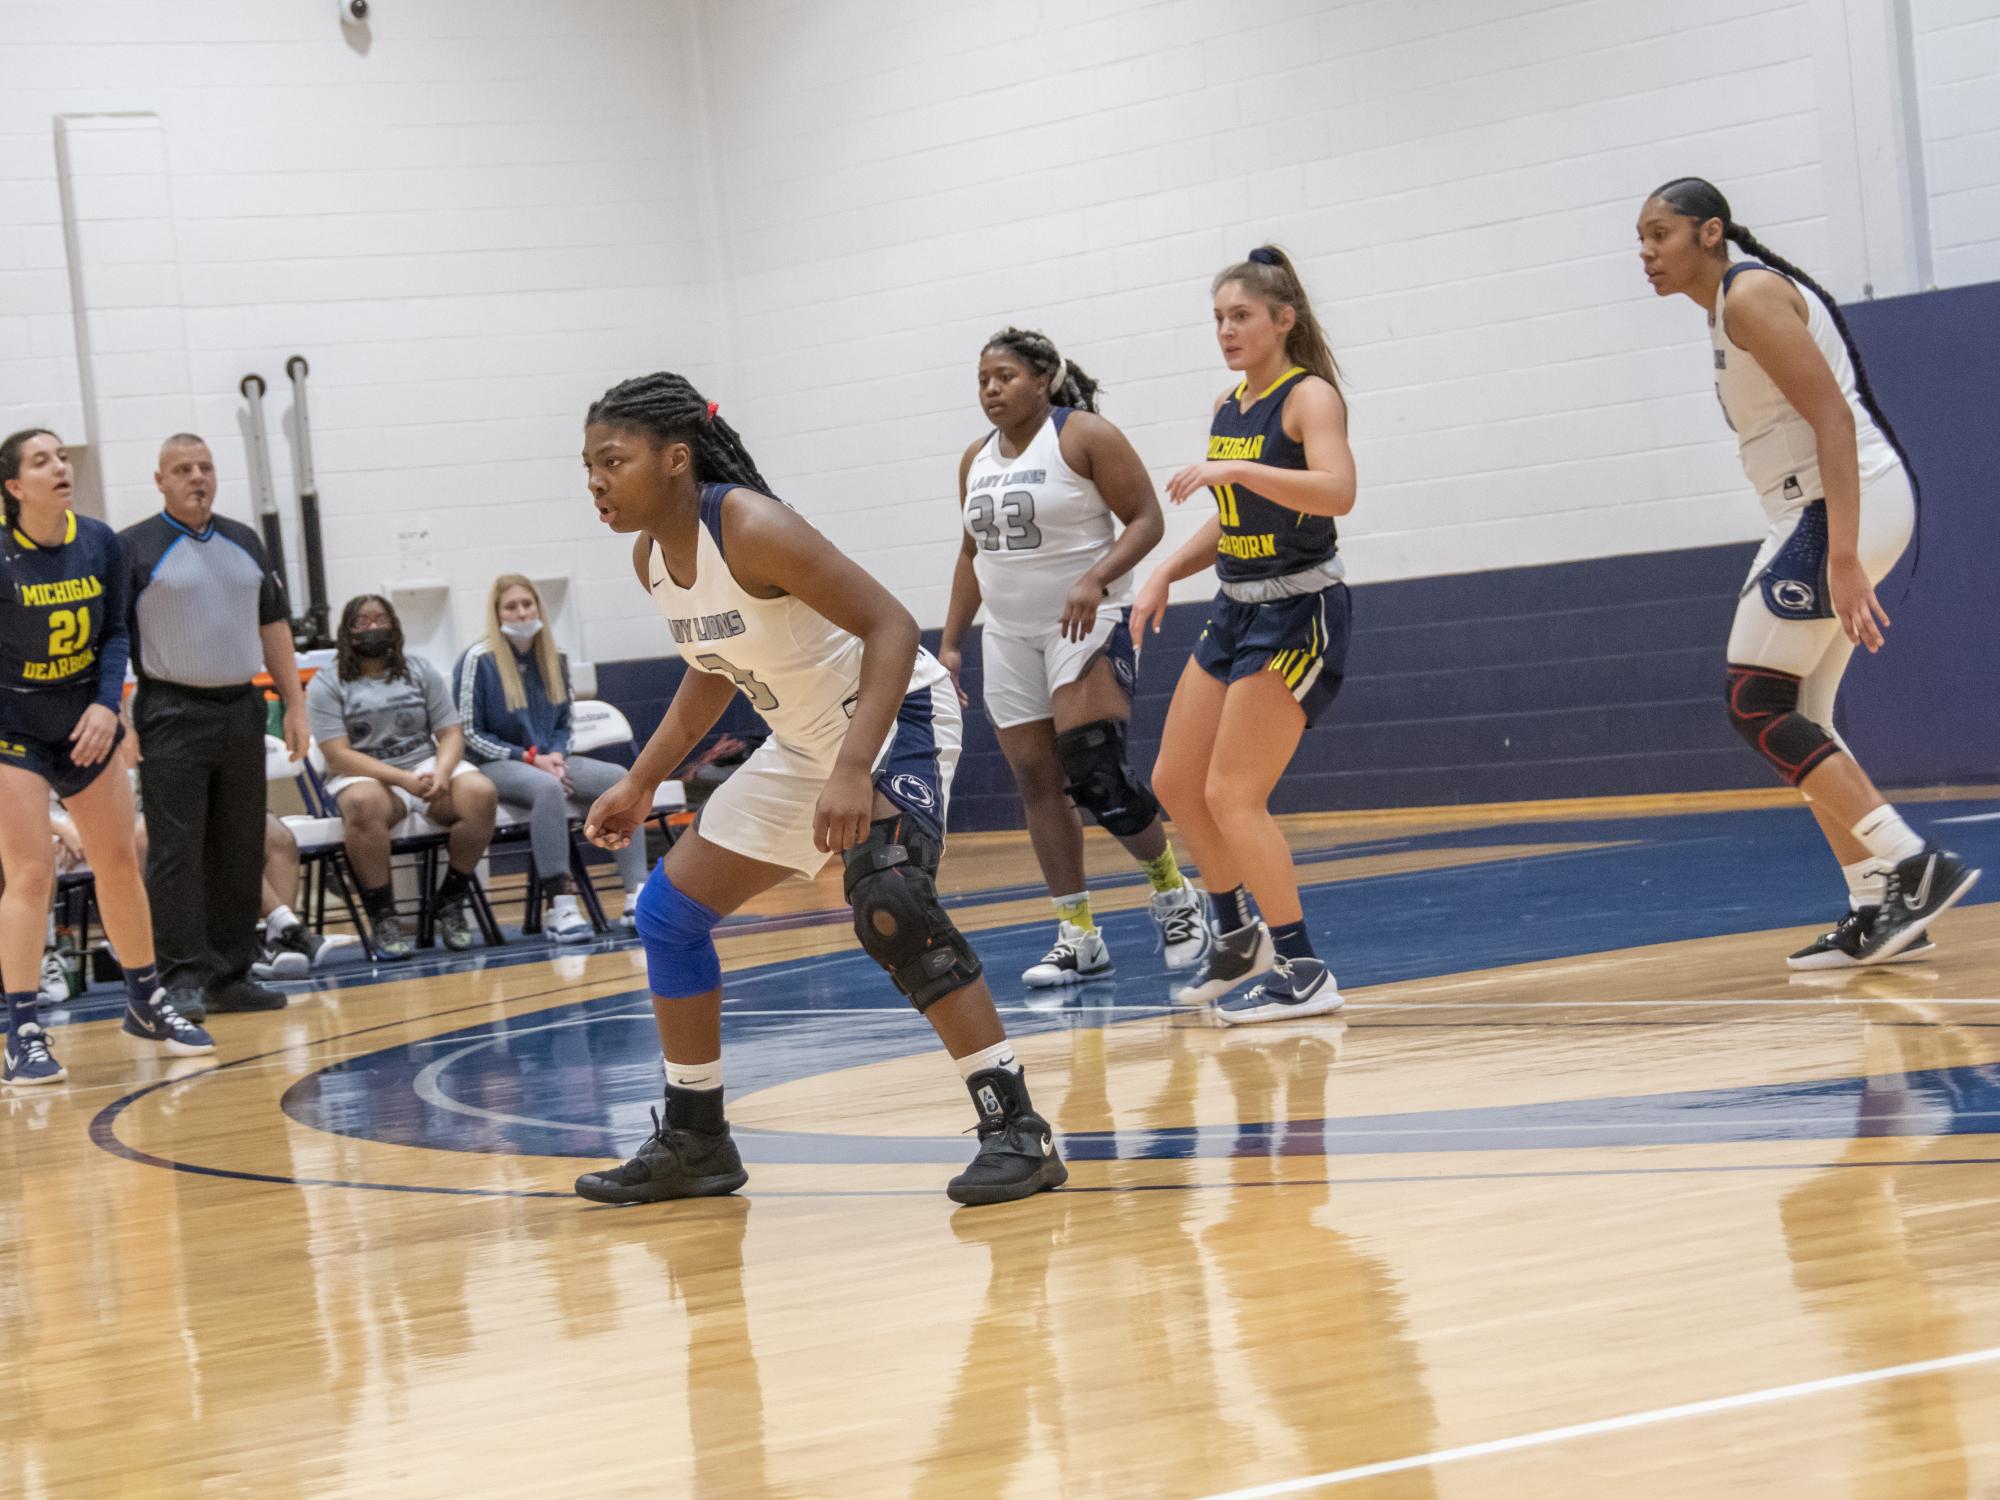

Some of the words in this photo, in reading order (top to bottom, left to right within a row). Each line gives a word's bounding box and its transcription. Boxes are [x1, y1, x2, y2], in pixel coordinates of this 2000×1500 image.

[1002, 468, 1047, 486] LIONS
[967, 490, 1042, 551] 33
[48, 606, 91, 656] 21
[692, 609, 746, 641] LIONS
[695, 652, 779, 711] 3
